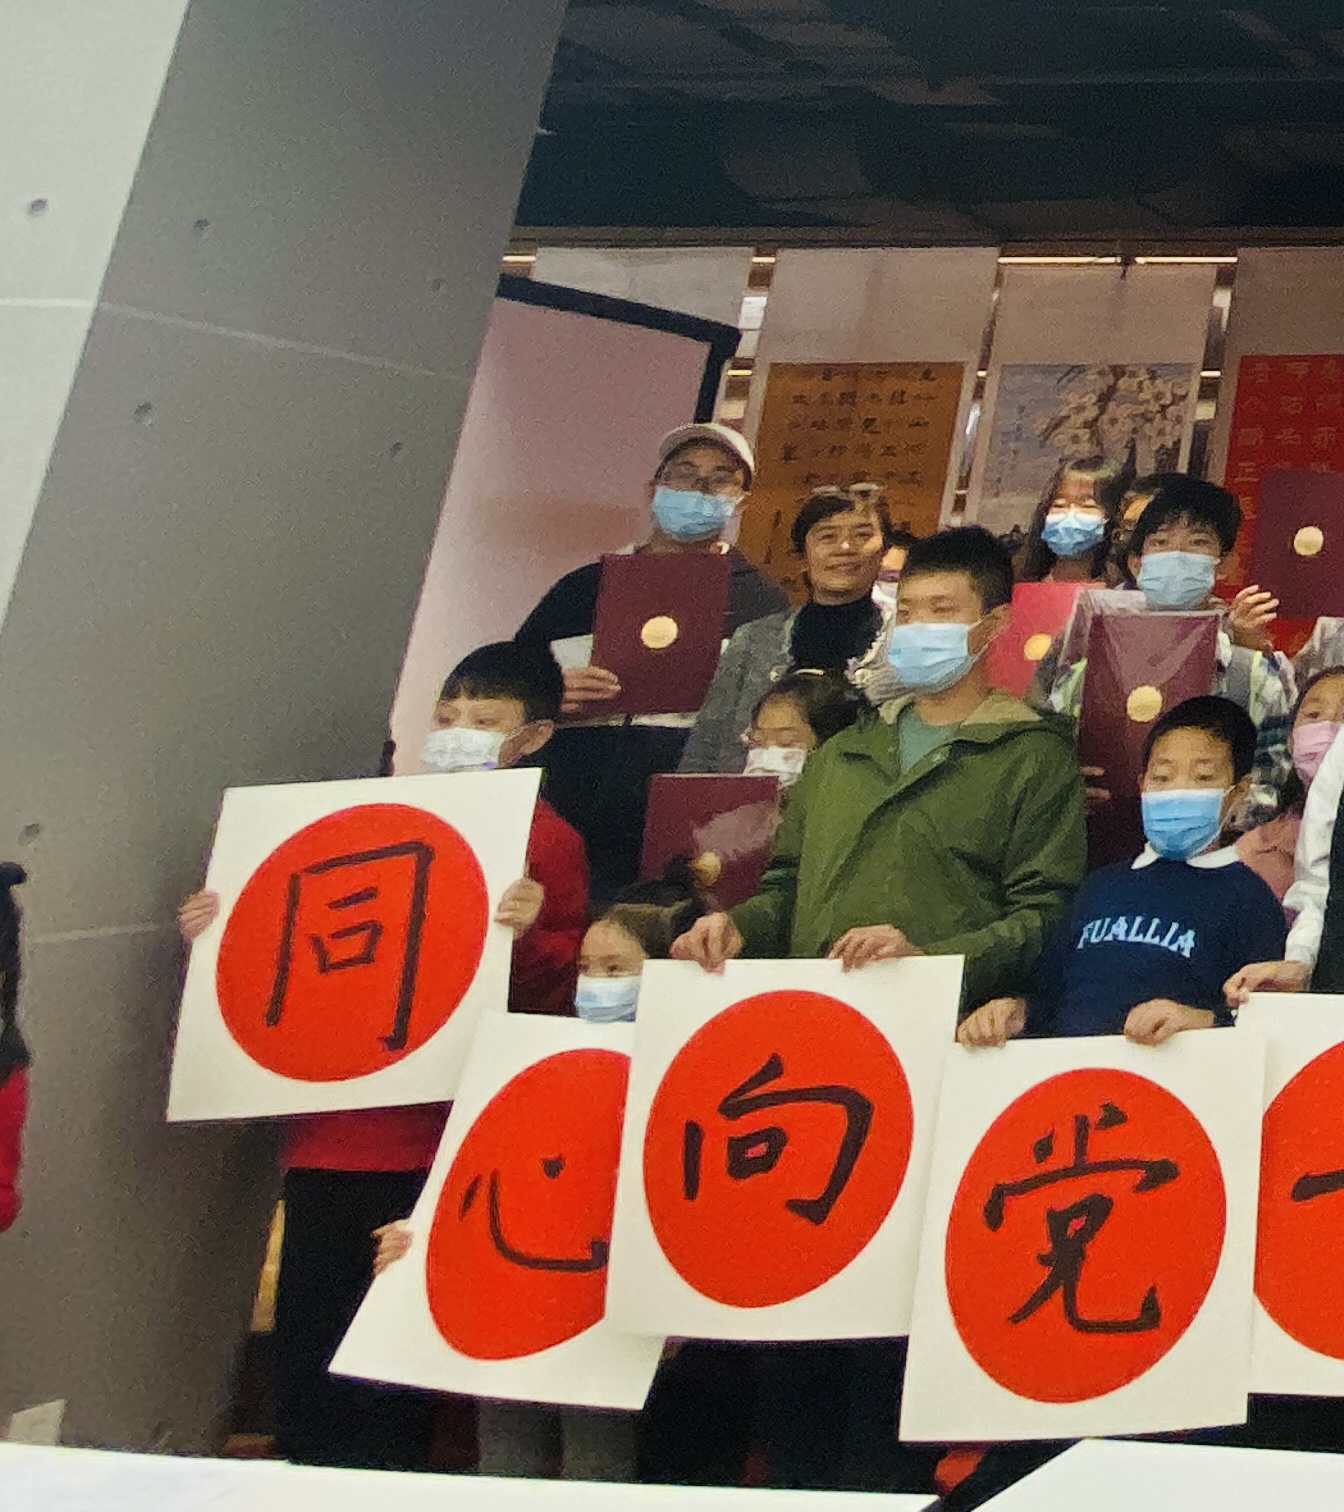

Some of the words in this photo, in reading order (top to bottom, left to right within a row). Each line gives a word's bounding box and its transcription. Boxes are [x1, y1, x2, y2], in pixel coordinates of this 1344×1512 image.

[265, 840, 434, 1051] 同
[459, 1153, 611, 1273] 心
[682, 1052, 875, 1226] 向
[982, 1101, 1180, 1335] 党
